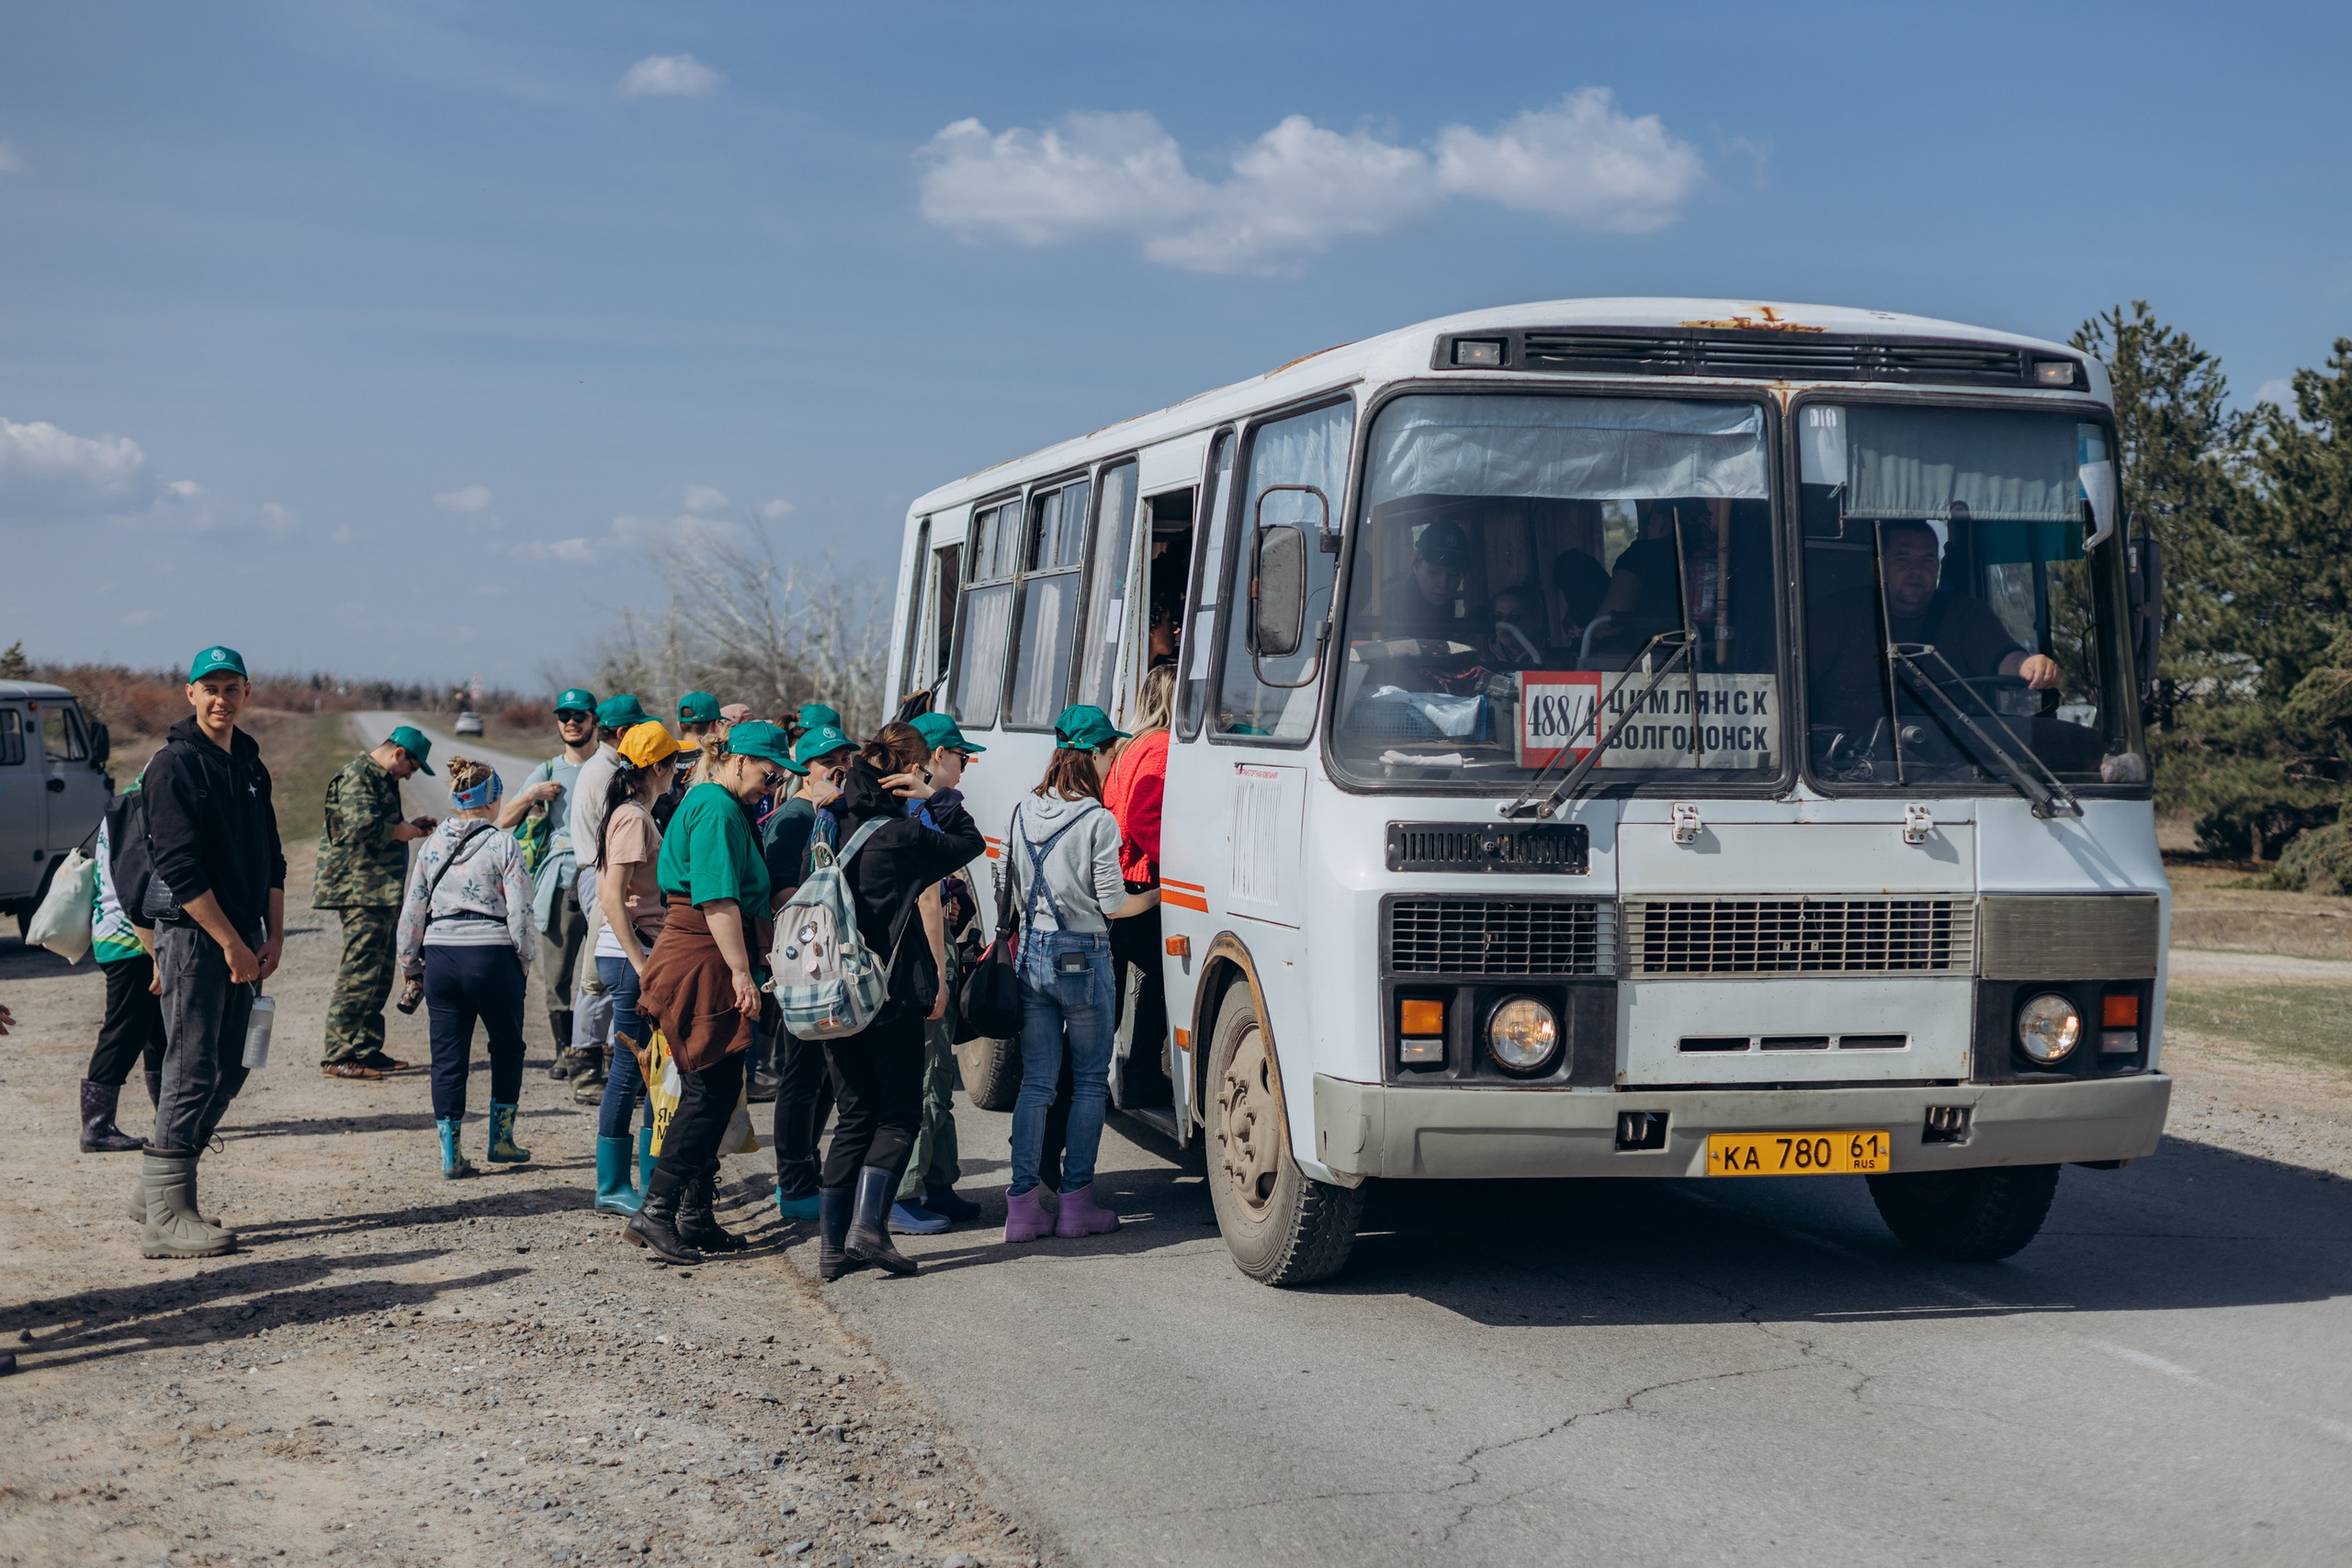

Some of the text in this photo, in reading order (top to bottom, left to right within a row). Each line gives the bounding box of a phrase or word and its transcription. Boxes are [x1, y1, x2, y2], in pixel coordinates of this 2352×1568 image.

[1527, 694, 1598, 737] 488/4
[1609, 689, 1768, 717] ЦИМЛЯНСК
[1608, 725, 1769, 755] ВОЛГОДОНСК
[1776, 1137, 1831, 1168] 780
[1850, 1134, 1878, 1157] 61
[1853, 1159, 1875, 1168] RUS
